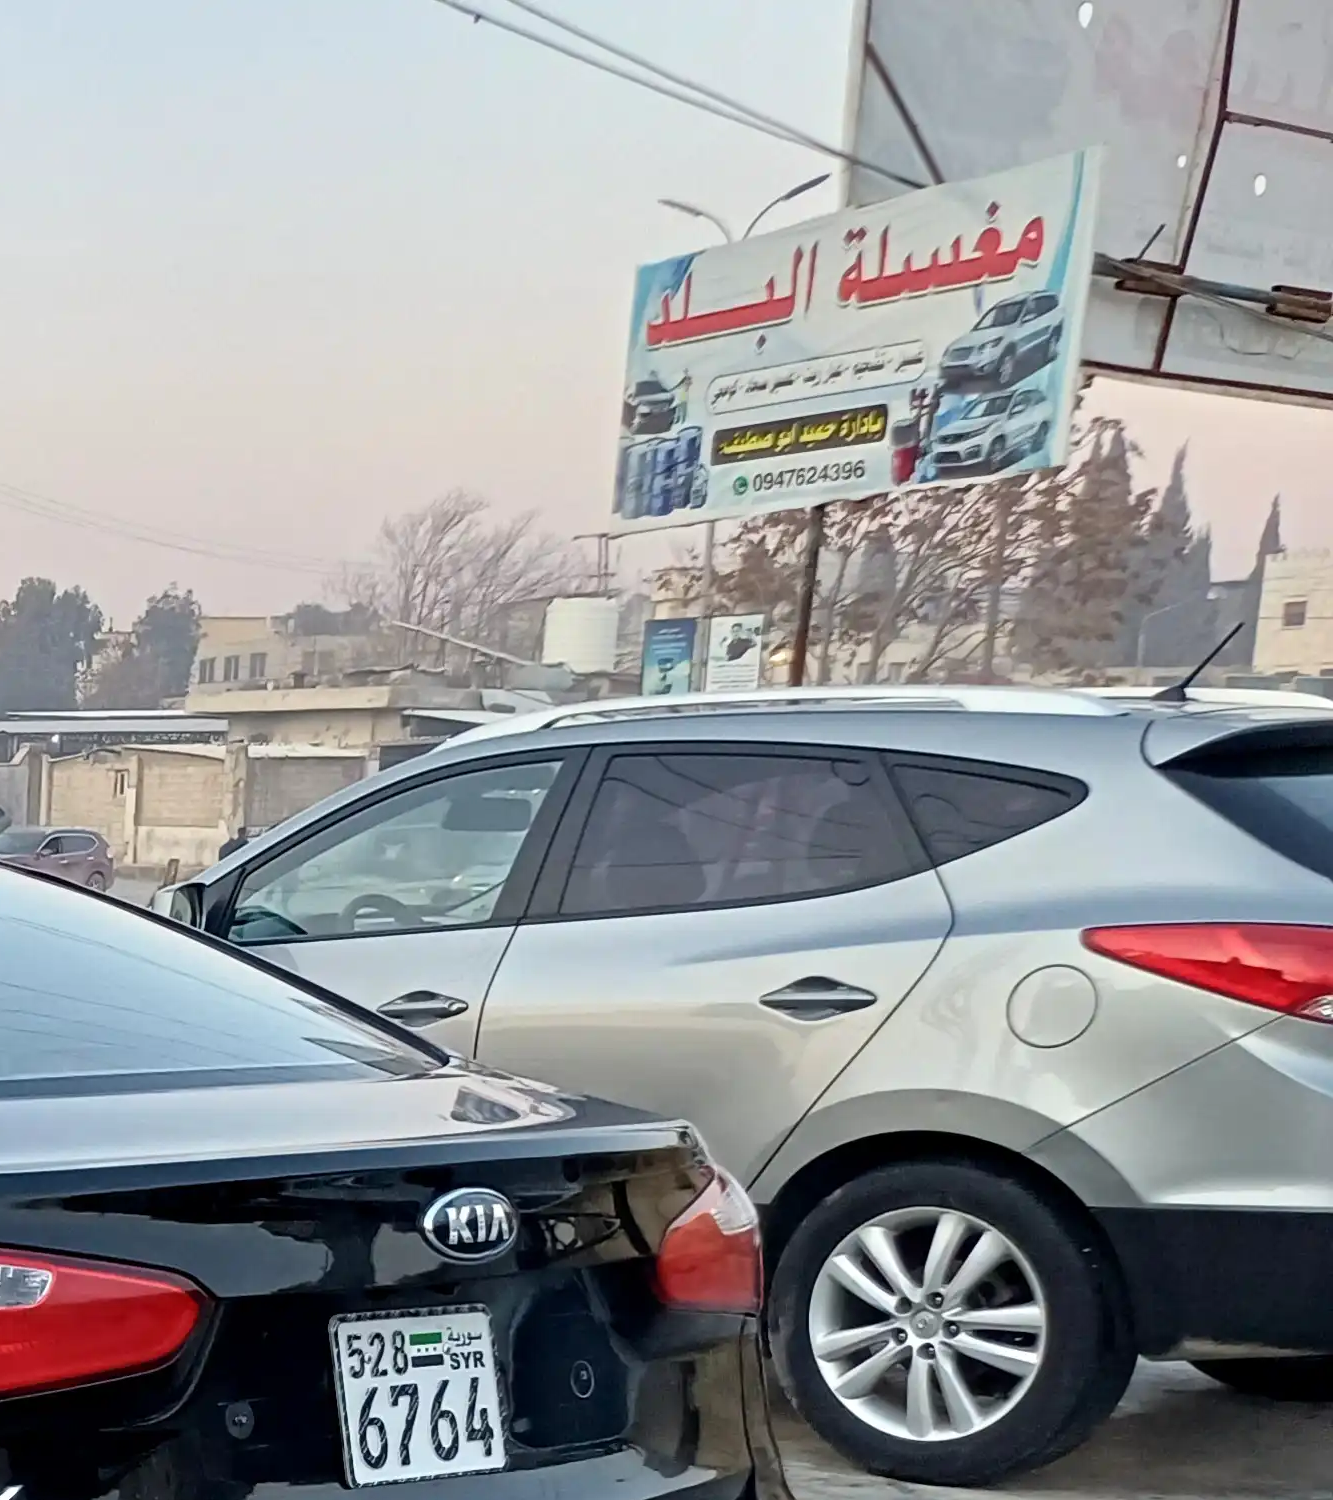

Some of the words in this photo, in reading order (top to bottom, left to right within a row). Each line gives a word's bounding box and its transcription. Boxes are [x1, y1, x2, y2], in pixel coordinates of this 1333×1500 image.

[836, 200, 1045, 308] مغسلة
[645, 241, 821, 354] البلد
[752, 459, 866, 493] 0947624396
[445, 1203, 510, 1245] KIA
[346, 1330, 410, 1379] 528
[446, 1326, 483, 1348] سورية
[449, 1351, 486, 1371] SYR
[358, 1376, 495, 1470] 6764
